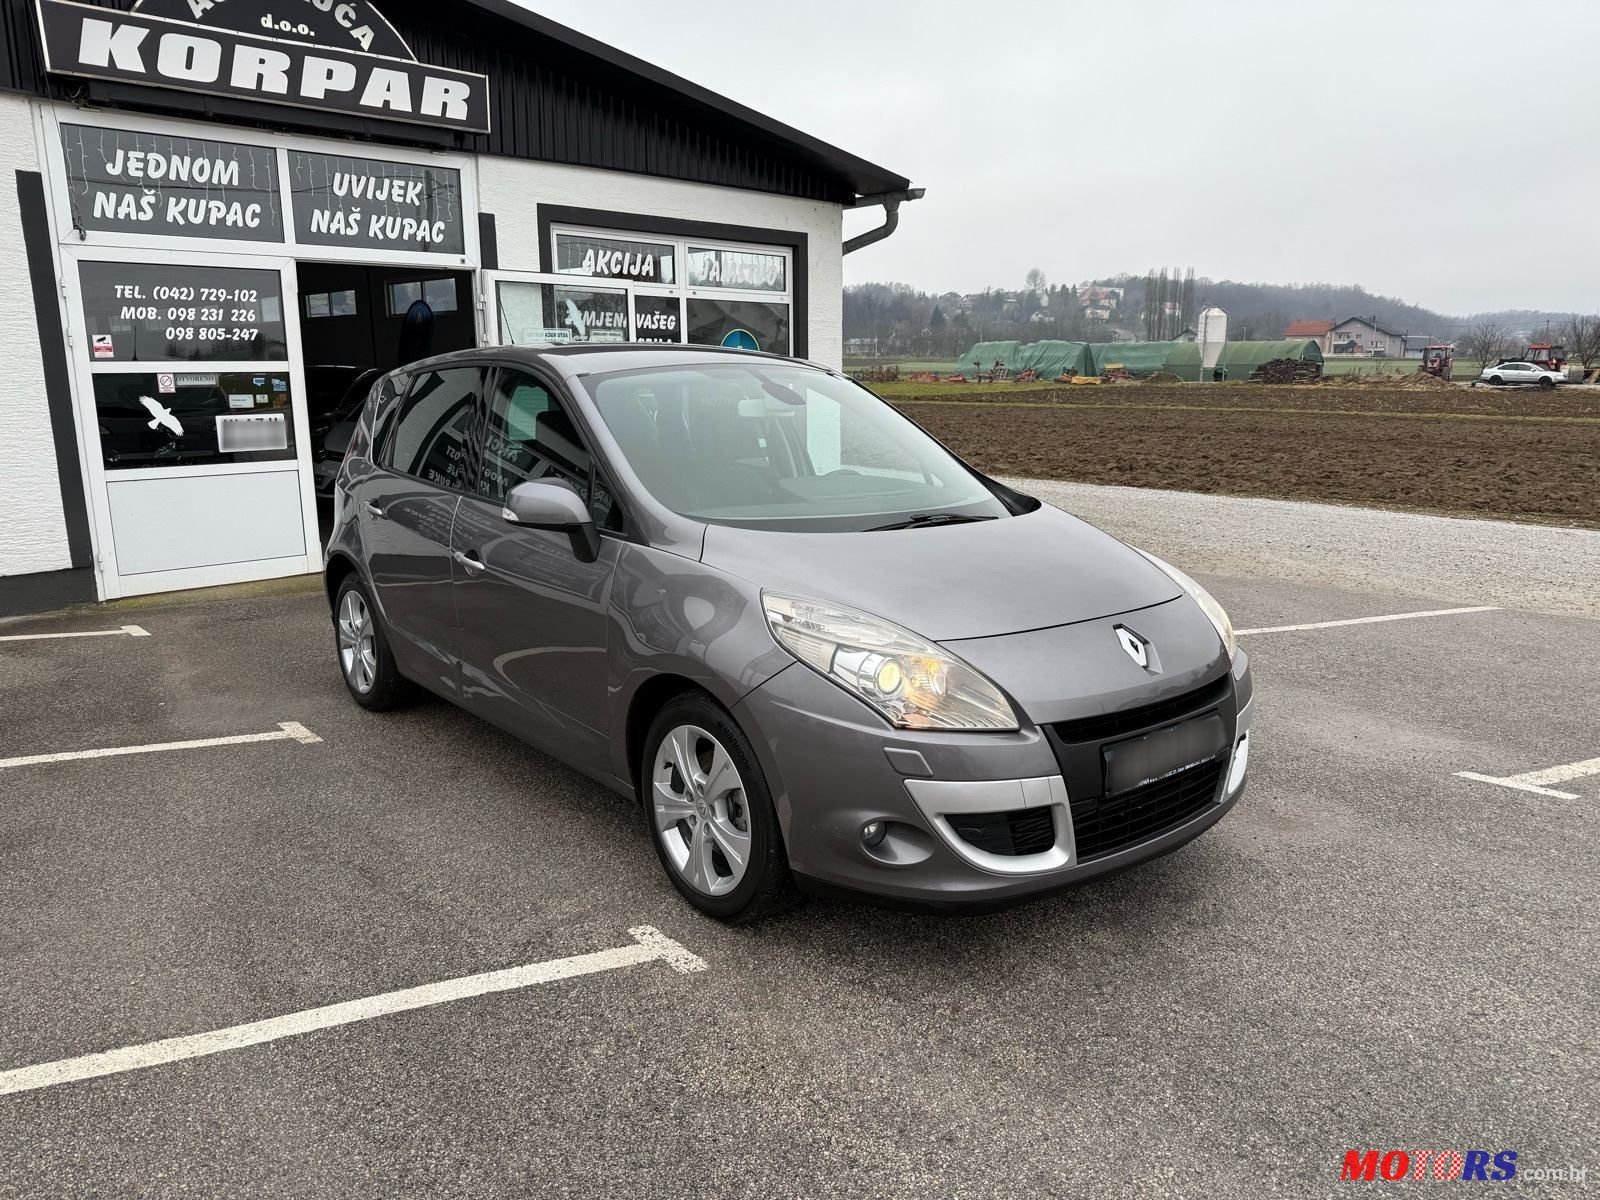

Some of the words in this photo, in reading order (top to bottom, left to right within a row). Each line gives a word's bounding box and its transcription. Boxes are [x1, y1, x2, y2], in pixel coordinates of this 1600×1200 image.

[260, 13, 316, 37] d.o.o.
[78, 16, 471, 121] KORPAR
[105, 148, 239, 187] JEDNOM
[332, 172, 424, 207] UVIJEK
[93, 189, 156, 222] NAŠ
[166, 196, 262, 228] KUPAC
[310, 206, 361, 236] NAŠ
[368, 216, 446, 244] KUPAC
[582, 248, 655, 278] AKCIJA
[114, 284, 146, 299] TEL.
[153, 285, 195, 301] (042)
[200, 287, 258, 303] 729-102
[120, 306, 162, 320] MOB.
[167, 307, 196, 322] 098
[200, 308, 224, 322] 231
[230, 308, 256, 322] 226
[636, 310, 677, 330] VAŠEG
[165, 326, 194, 341] 098
[198, 327, 259, 342] 805-247
